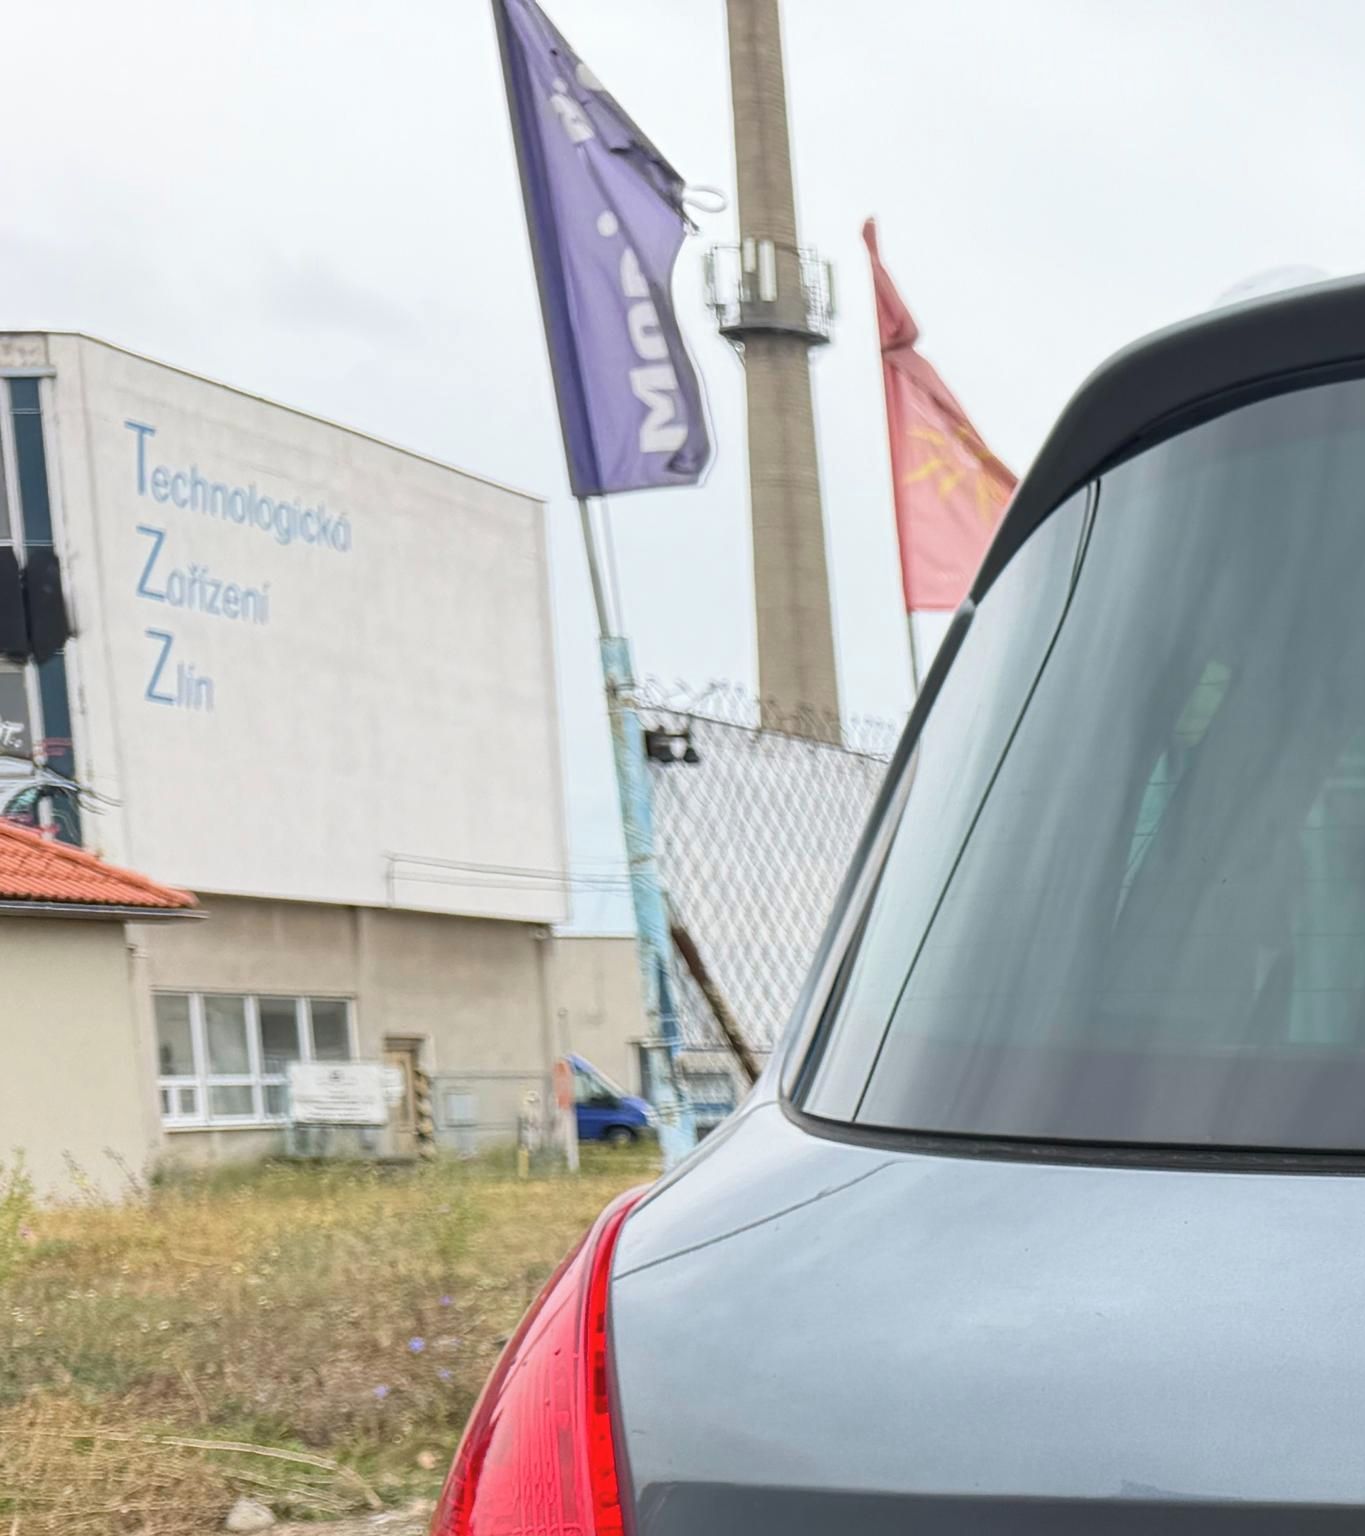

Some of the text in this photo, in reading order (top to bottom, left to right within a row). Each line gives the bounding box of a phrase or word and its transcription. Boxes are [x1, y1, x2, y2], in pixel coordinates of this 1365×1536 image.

[124, 420, 351, 552] Technologická
[136, 523, 270, 625] Zařízení
[145, 627, 214, 711] Zlín
